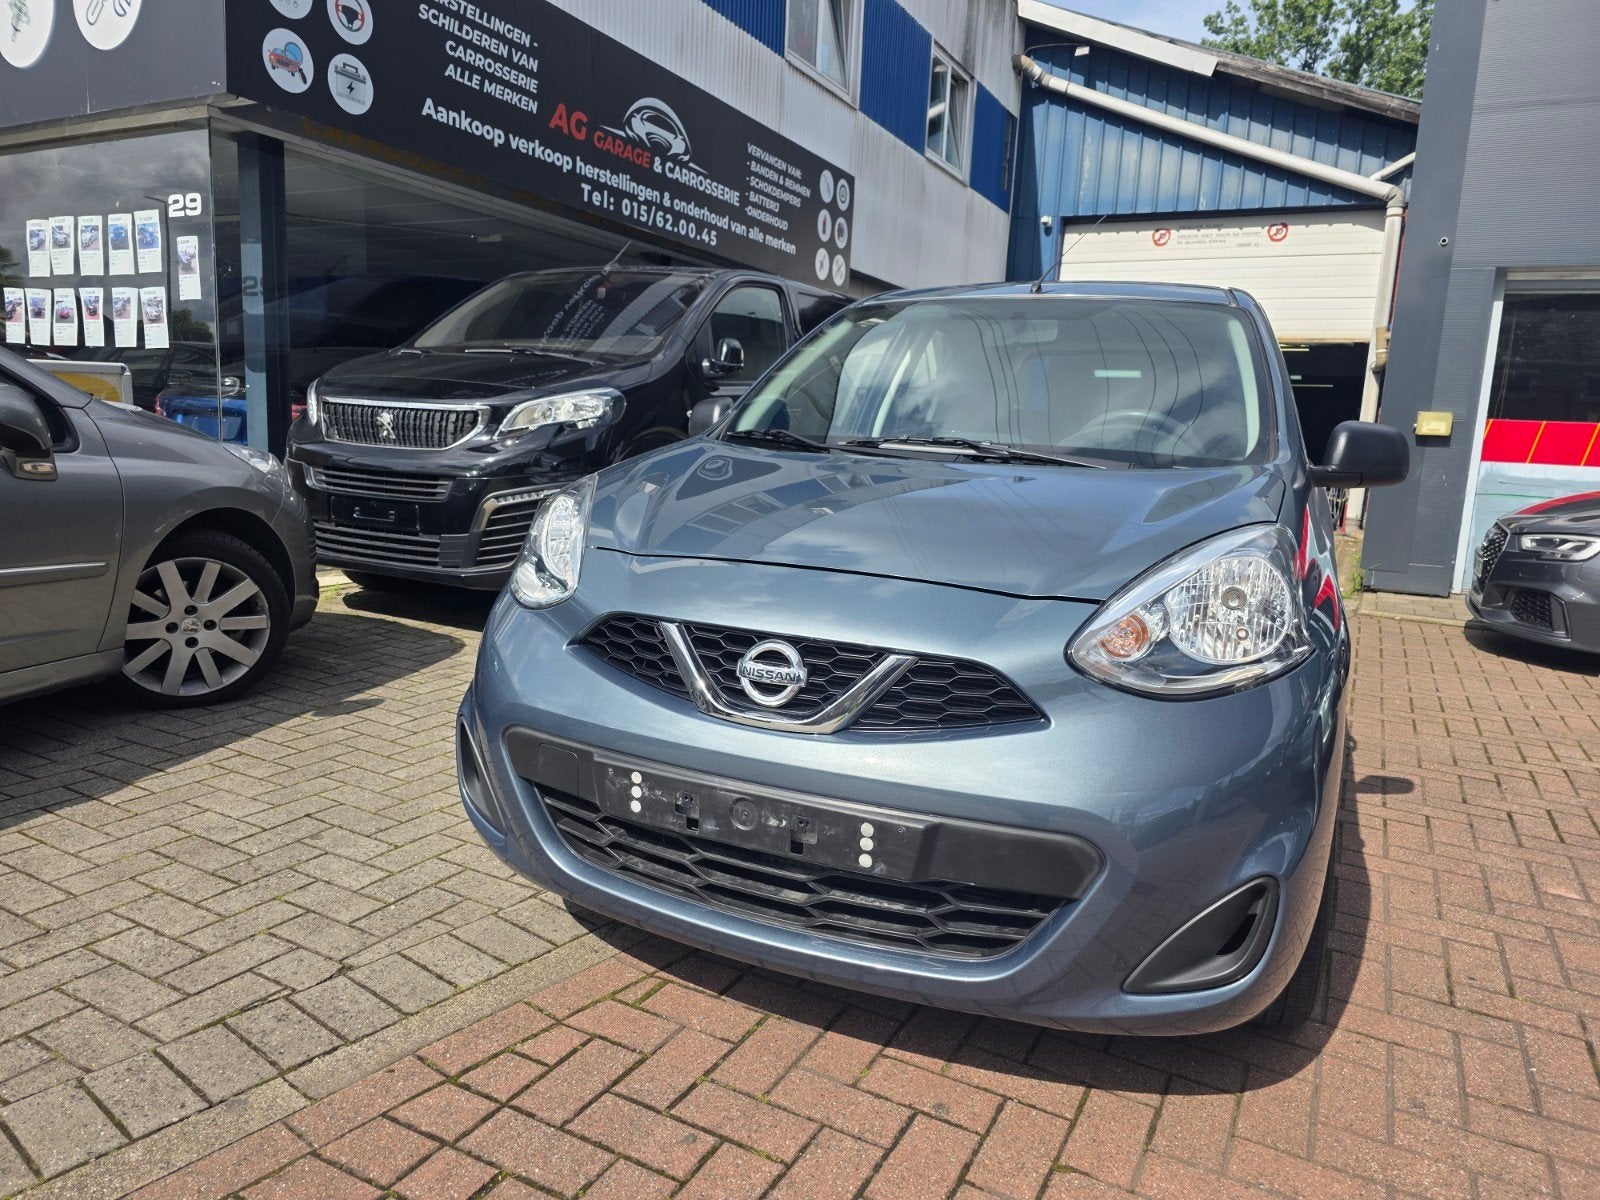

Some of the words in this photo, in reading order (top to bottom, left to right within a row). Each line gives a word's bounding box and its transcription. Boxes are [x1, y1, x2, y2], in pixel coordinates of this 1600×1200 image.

[418, 4, 508, 58] SCHILDEREN
[511, 47, 538, 73] VAN
[433, 0, 531, 47] RSTELLINGEN
[444, 63, 481, 90] ALLE
[483, 79, 538, 114] MERKEN
[445, 40, 538, 93] CARROSSERIE
[421, 98, 505, 147] Aankoop
[509, 133, 573, 172] verkoop
[576, 156, 660, 204] herstellingen
[663, 191, 672, 207] &
[673, 198, 729, 230] onderhoud
[730, 219, 746, 237] van
[748, 226, 764, 243] alle
[765, 234, 796, 255] merken
[549, 103, 588, 141] AG
[593, 130, 652, 169] GARAGE
[653, 156, 663, 174] &
[665, 161, 740, 207] CARROSSERIE
[747, 142, 787, 171] VERVANGEN
[788, 164, 802, 179] VAN:
[750, 160, 779, 183] BANDEN
[784, 178, 811, 198] REMMEN
[168, 193, 201, 217] 29
[581, 183, 615, 211] Tel:
[621, 198, 717, 247] 015/62.00.45
[750, 176, 801, 208] SCHOKDEMPERS
[741, 664, 797, 683] NISSAN
